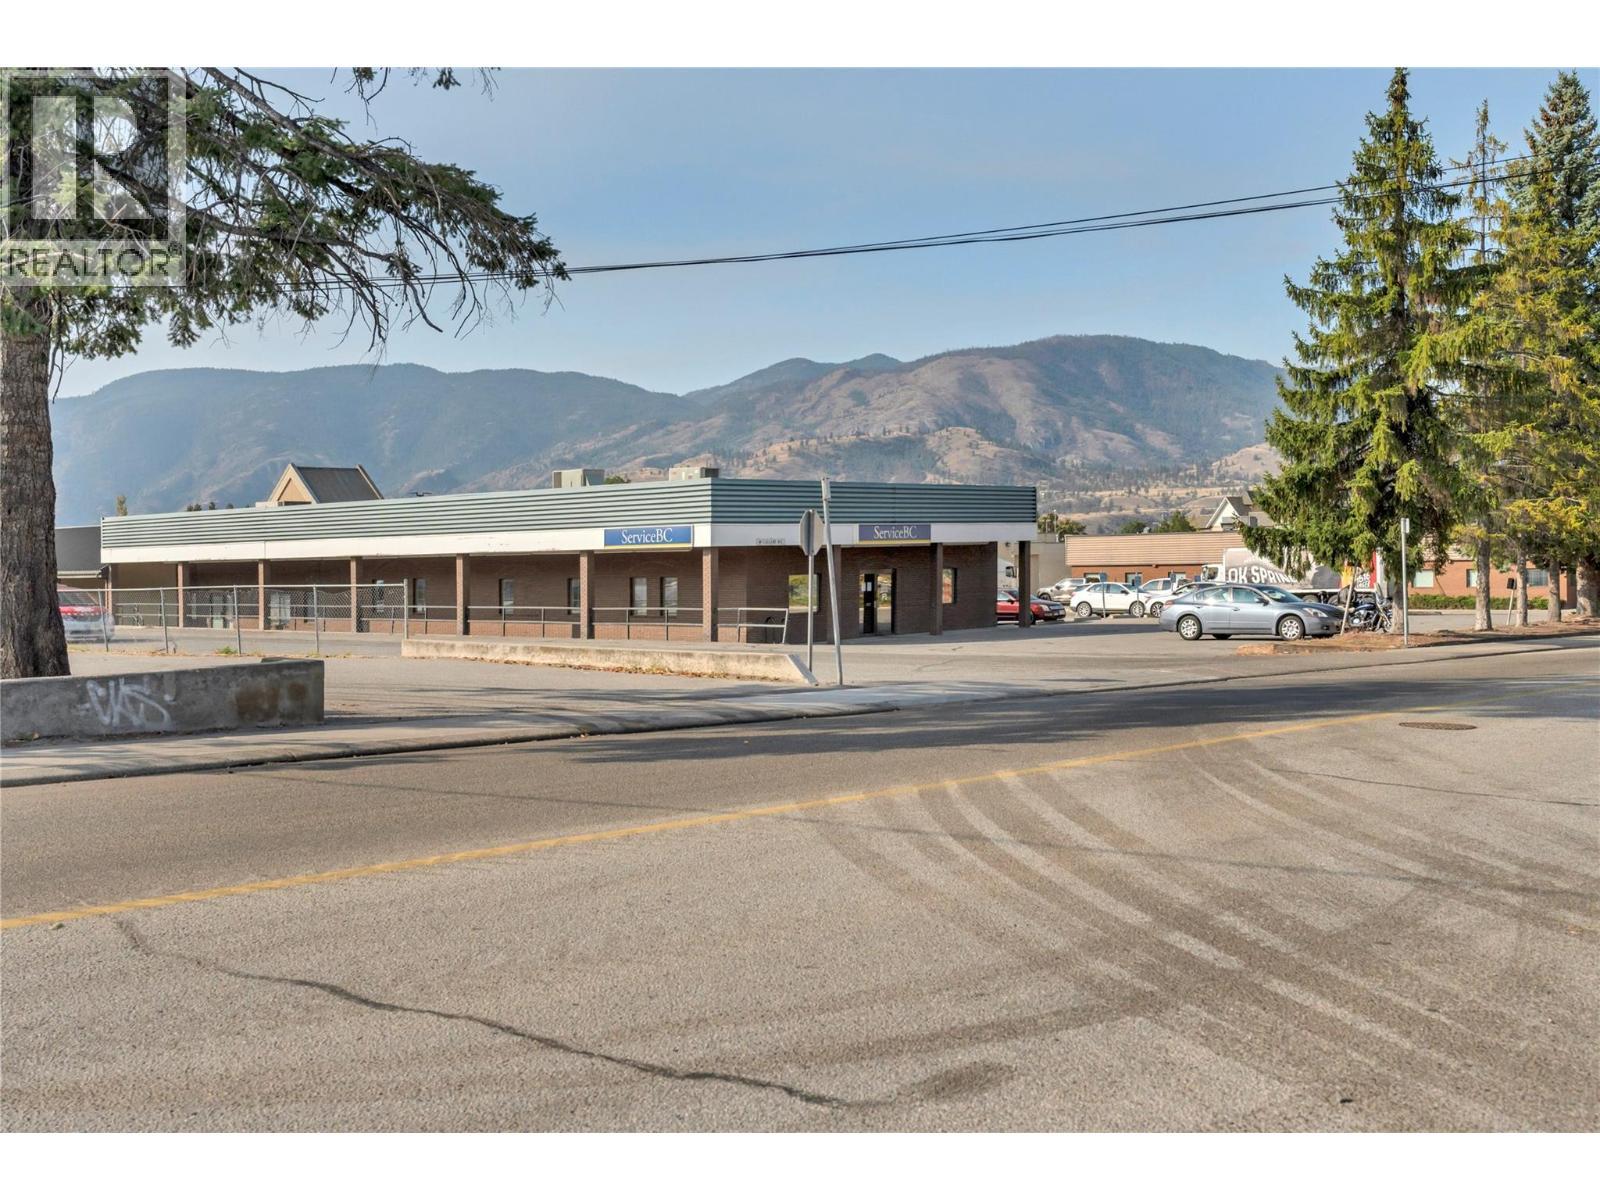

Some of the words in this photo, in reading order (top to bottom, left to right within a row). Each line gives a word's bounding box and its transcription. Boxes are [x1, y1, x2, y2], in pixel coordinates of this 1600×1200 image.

[621, 527, 673, 544] ServiceBC
[873, 525, 918, 539] ServiceBC
[1226, 566, 1248, 584] OK
